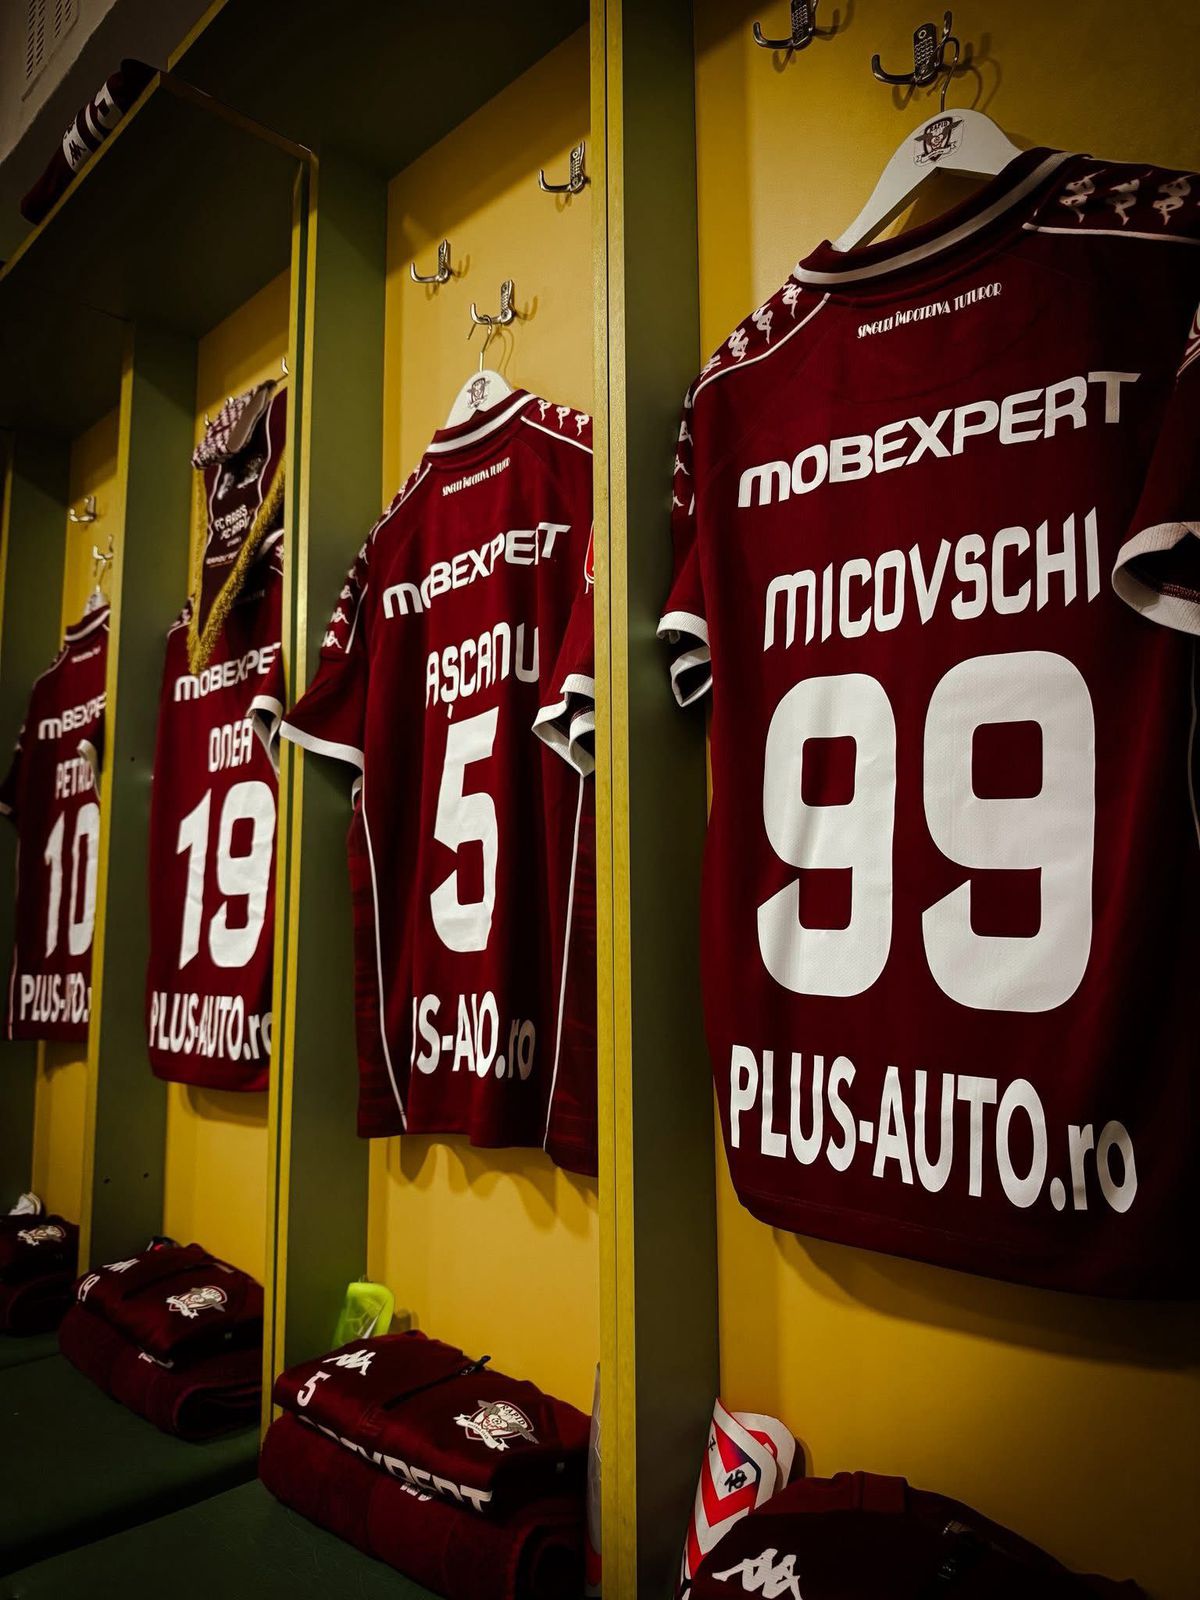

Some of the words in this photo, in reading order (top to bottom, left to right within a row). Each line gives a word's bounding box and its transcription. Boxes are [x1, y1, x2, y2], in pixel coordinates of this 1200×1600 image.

[953, 282, 1003, 311] TUTUROR
[737, 370, 1141, 509] MOBEXPERT
[763, 506, 1101, 652] MICOVSCHI
[208, 717, 254, 773] ONEA
[44, 802, 100, 958] 10
[176, 780, 277, 970] 19
[429, 706, 499, 953] 5
[757, 652, 1095, 1013] 99
[729, 1043, 1138, 1215] PLUS-AUTO.ro
[296, 1370, 331, 1407] 5
[500, 1404, 526, 1426] RAPID
